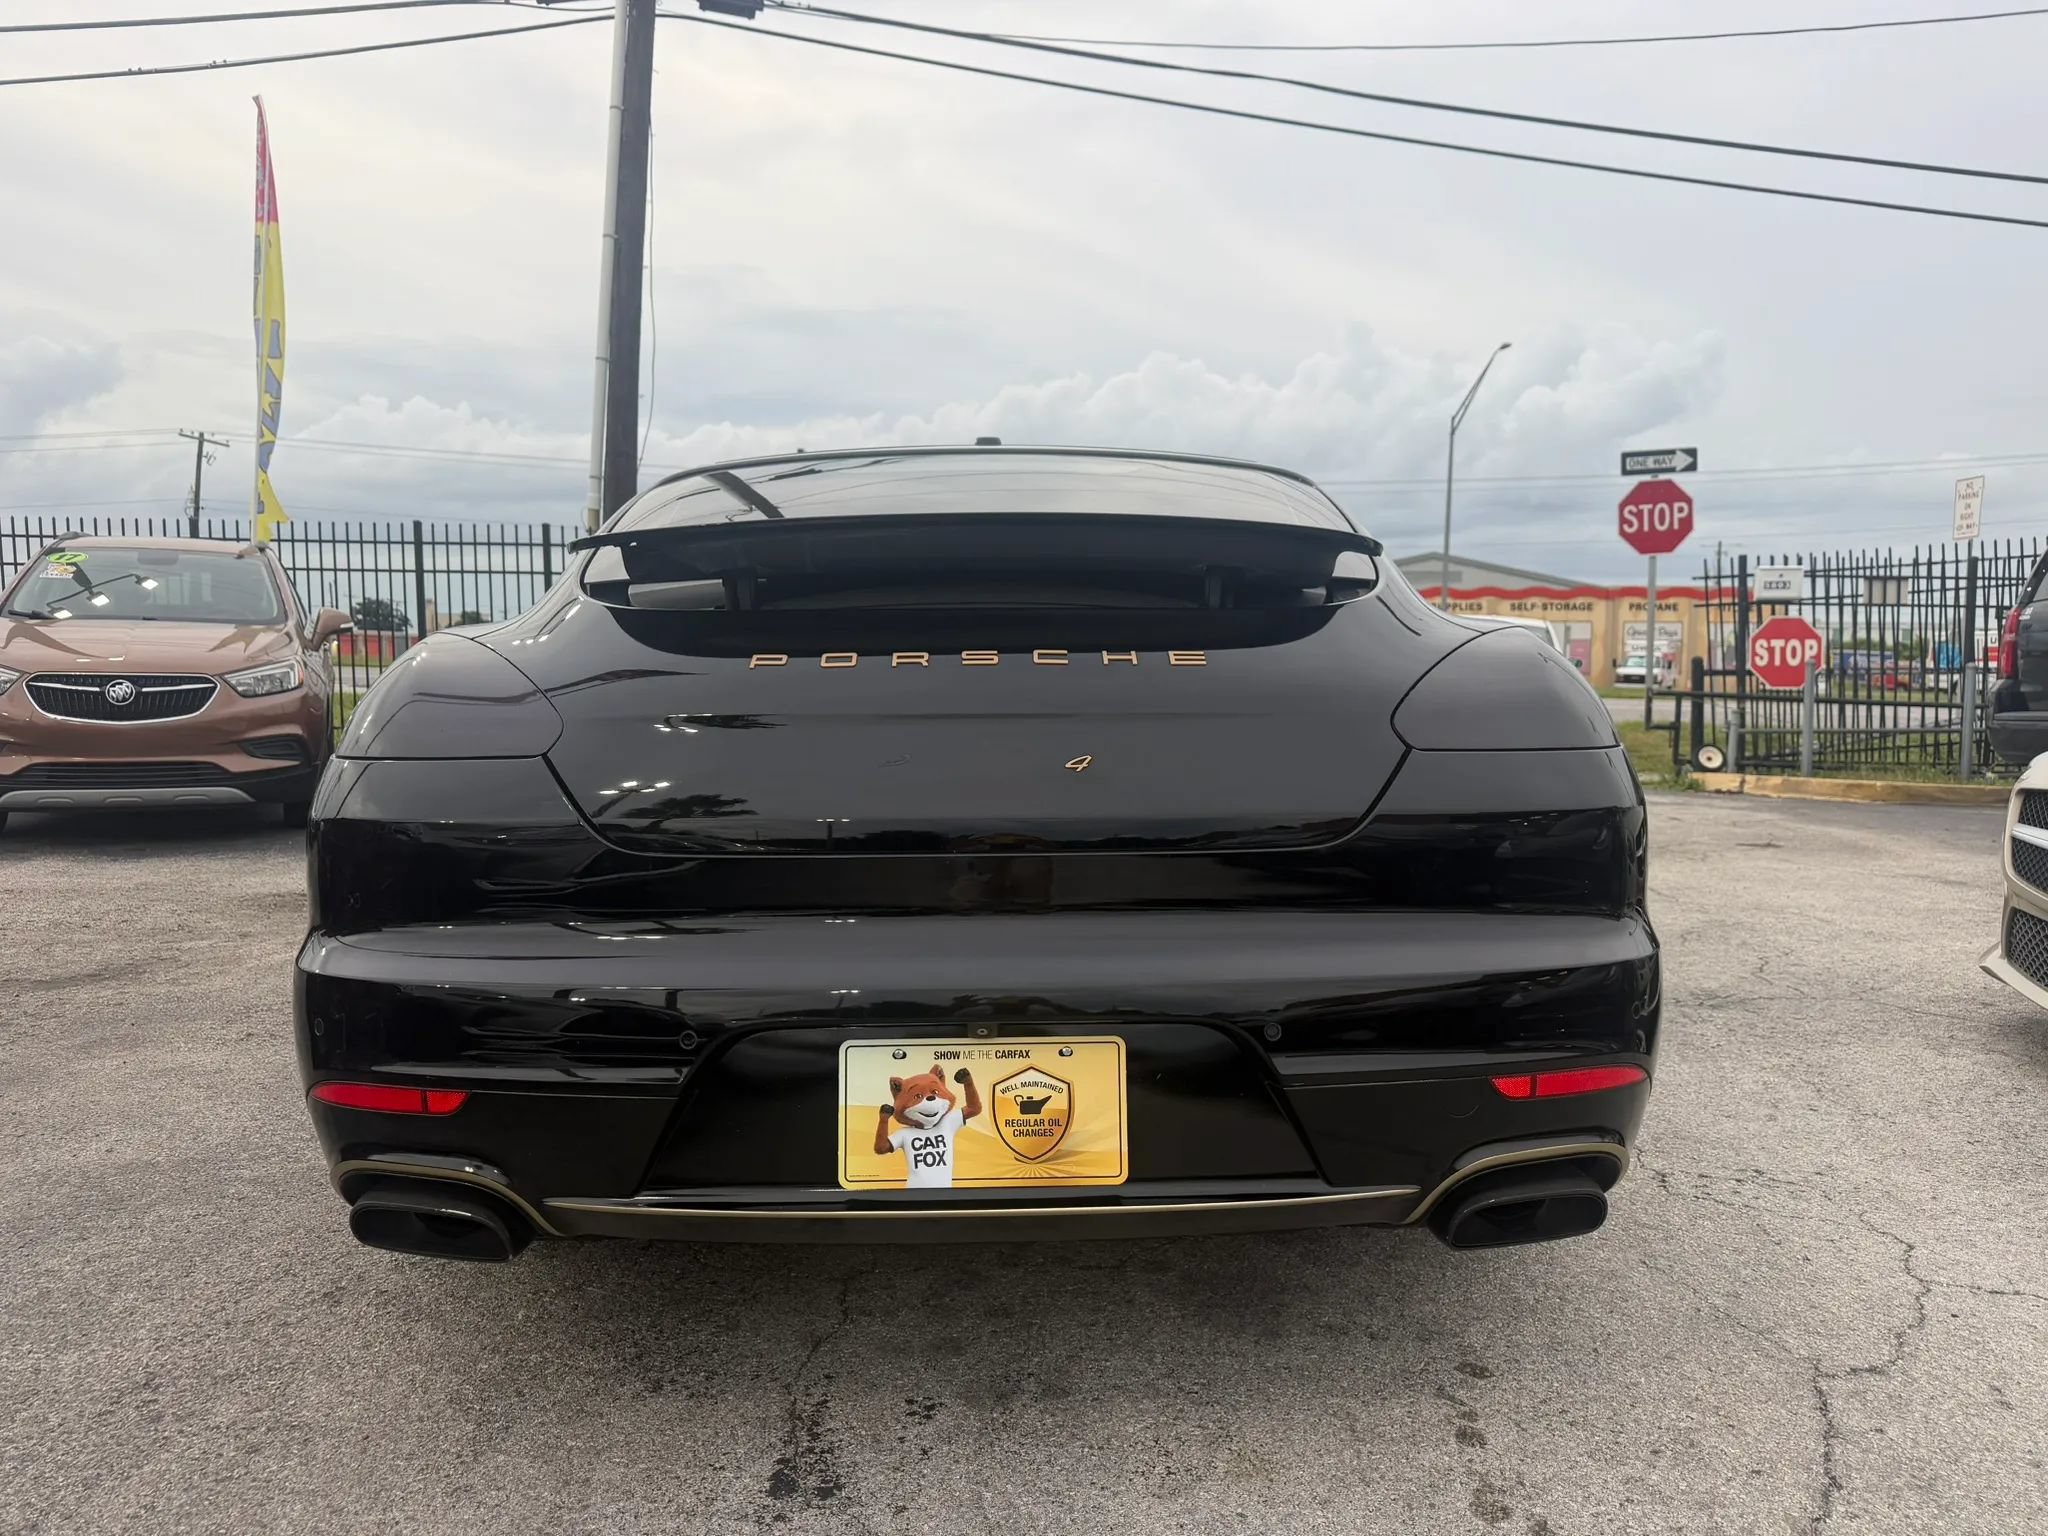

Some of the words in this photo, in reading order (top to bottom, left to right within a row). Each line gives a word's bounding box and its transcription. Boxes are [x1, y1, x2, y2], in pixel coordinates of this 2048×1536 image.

[1628, 457, 1647, 467] ONE
[1652, 455, 1674, 465] WAY
[1622, 502, 1689, 533] STOP
[749, 649, 1207, 669] PORSCHE
[1754, 638, 1818, 667] STOP
[1064, 754, 1093, 772] 4
[934, 1050, 961, 1060] SHOW
[962, 1050, 976, 1060] ME
[977, 1050, 993, 1060] THE
[994, 1049, 1031, 1060] CARFAX
[1000, 1083, 1020, 1095] WELL
[1020, 1081, 1064, 1094] MAINTAINED
[1005, 1118, 1045, 1128] REGULAR
[1048, 1118, 1062, 1127] OIL
[1012, 1128, 1055, 1138] CHANGES
[911, 1134, 947, 1151] CAR
[913, 1150, 947, 1169] FOX
